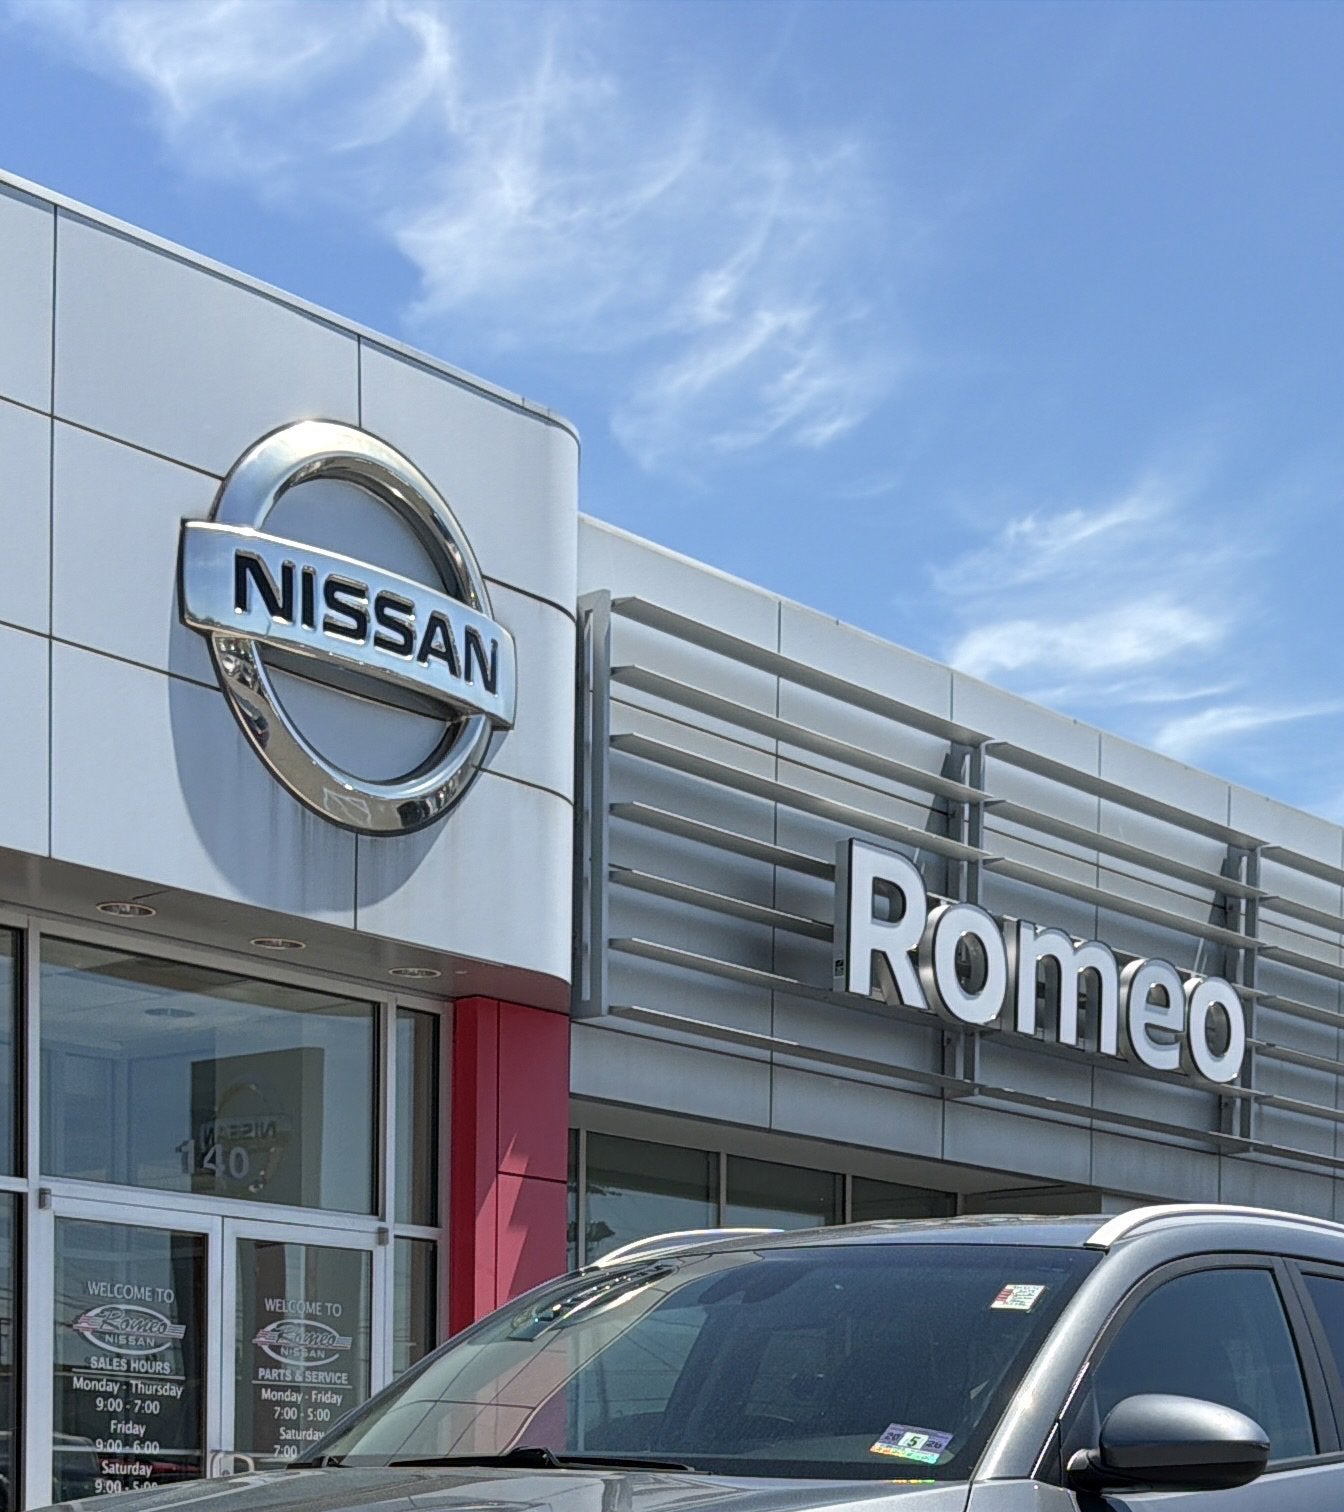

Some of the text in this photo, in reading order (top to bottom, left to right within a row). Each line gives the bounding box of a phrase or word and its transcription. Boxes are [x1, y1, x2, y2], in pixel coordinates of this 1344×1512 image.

[234, 549, 498, 697] NISSAN
[839, 837, 1246, 1083] Romeo
[179, 1138, 250, 1180] 140
[87, 1280, 175, 1304] WELCOME TO
[264, 1298, 342, 1317] WELCOME TO
[96, 1307, 168, 1335] Romeo
[105, 1334, 155, 1348] NISSAN
[274, 1322, 337, 1346] Romeo
[280, 1346, 326, 1359] NISSAN
[90, 1355, 171, 1375] SALES HOURS
[258, 1367, 349, 1384] PARTS & SERVICE
[72, 1376, 121, 1394] Monday
[129, 1379, 184, 1400] Thursday
[261, 1387, 303, 1404] Monday
[311, 1390, 343, 1406] Friday
[95, 1397, 123, 1412] 9:00
[133, 1399, 160, 1415] 7:00
[273, 1406, 298, 1420] 7:00
[307, 1408, 331, 1421] 5:00
[110, 1419, 146, 1437] Friday
[95, 1438, 123, 1453] 9:00
[133, 1440, 160, 1454] 6:00
[907, 1435, 921, 1447] 5
[273, 1444, 297, 1458] 7:00
[101, 1460, 153, 1478] Saturday
[94, 1479, 122, 1494] 9:00
